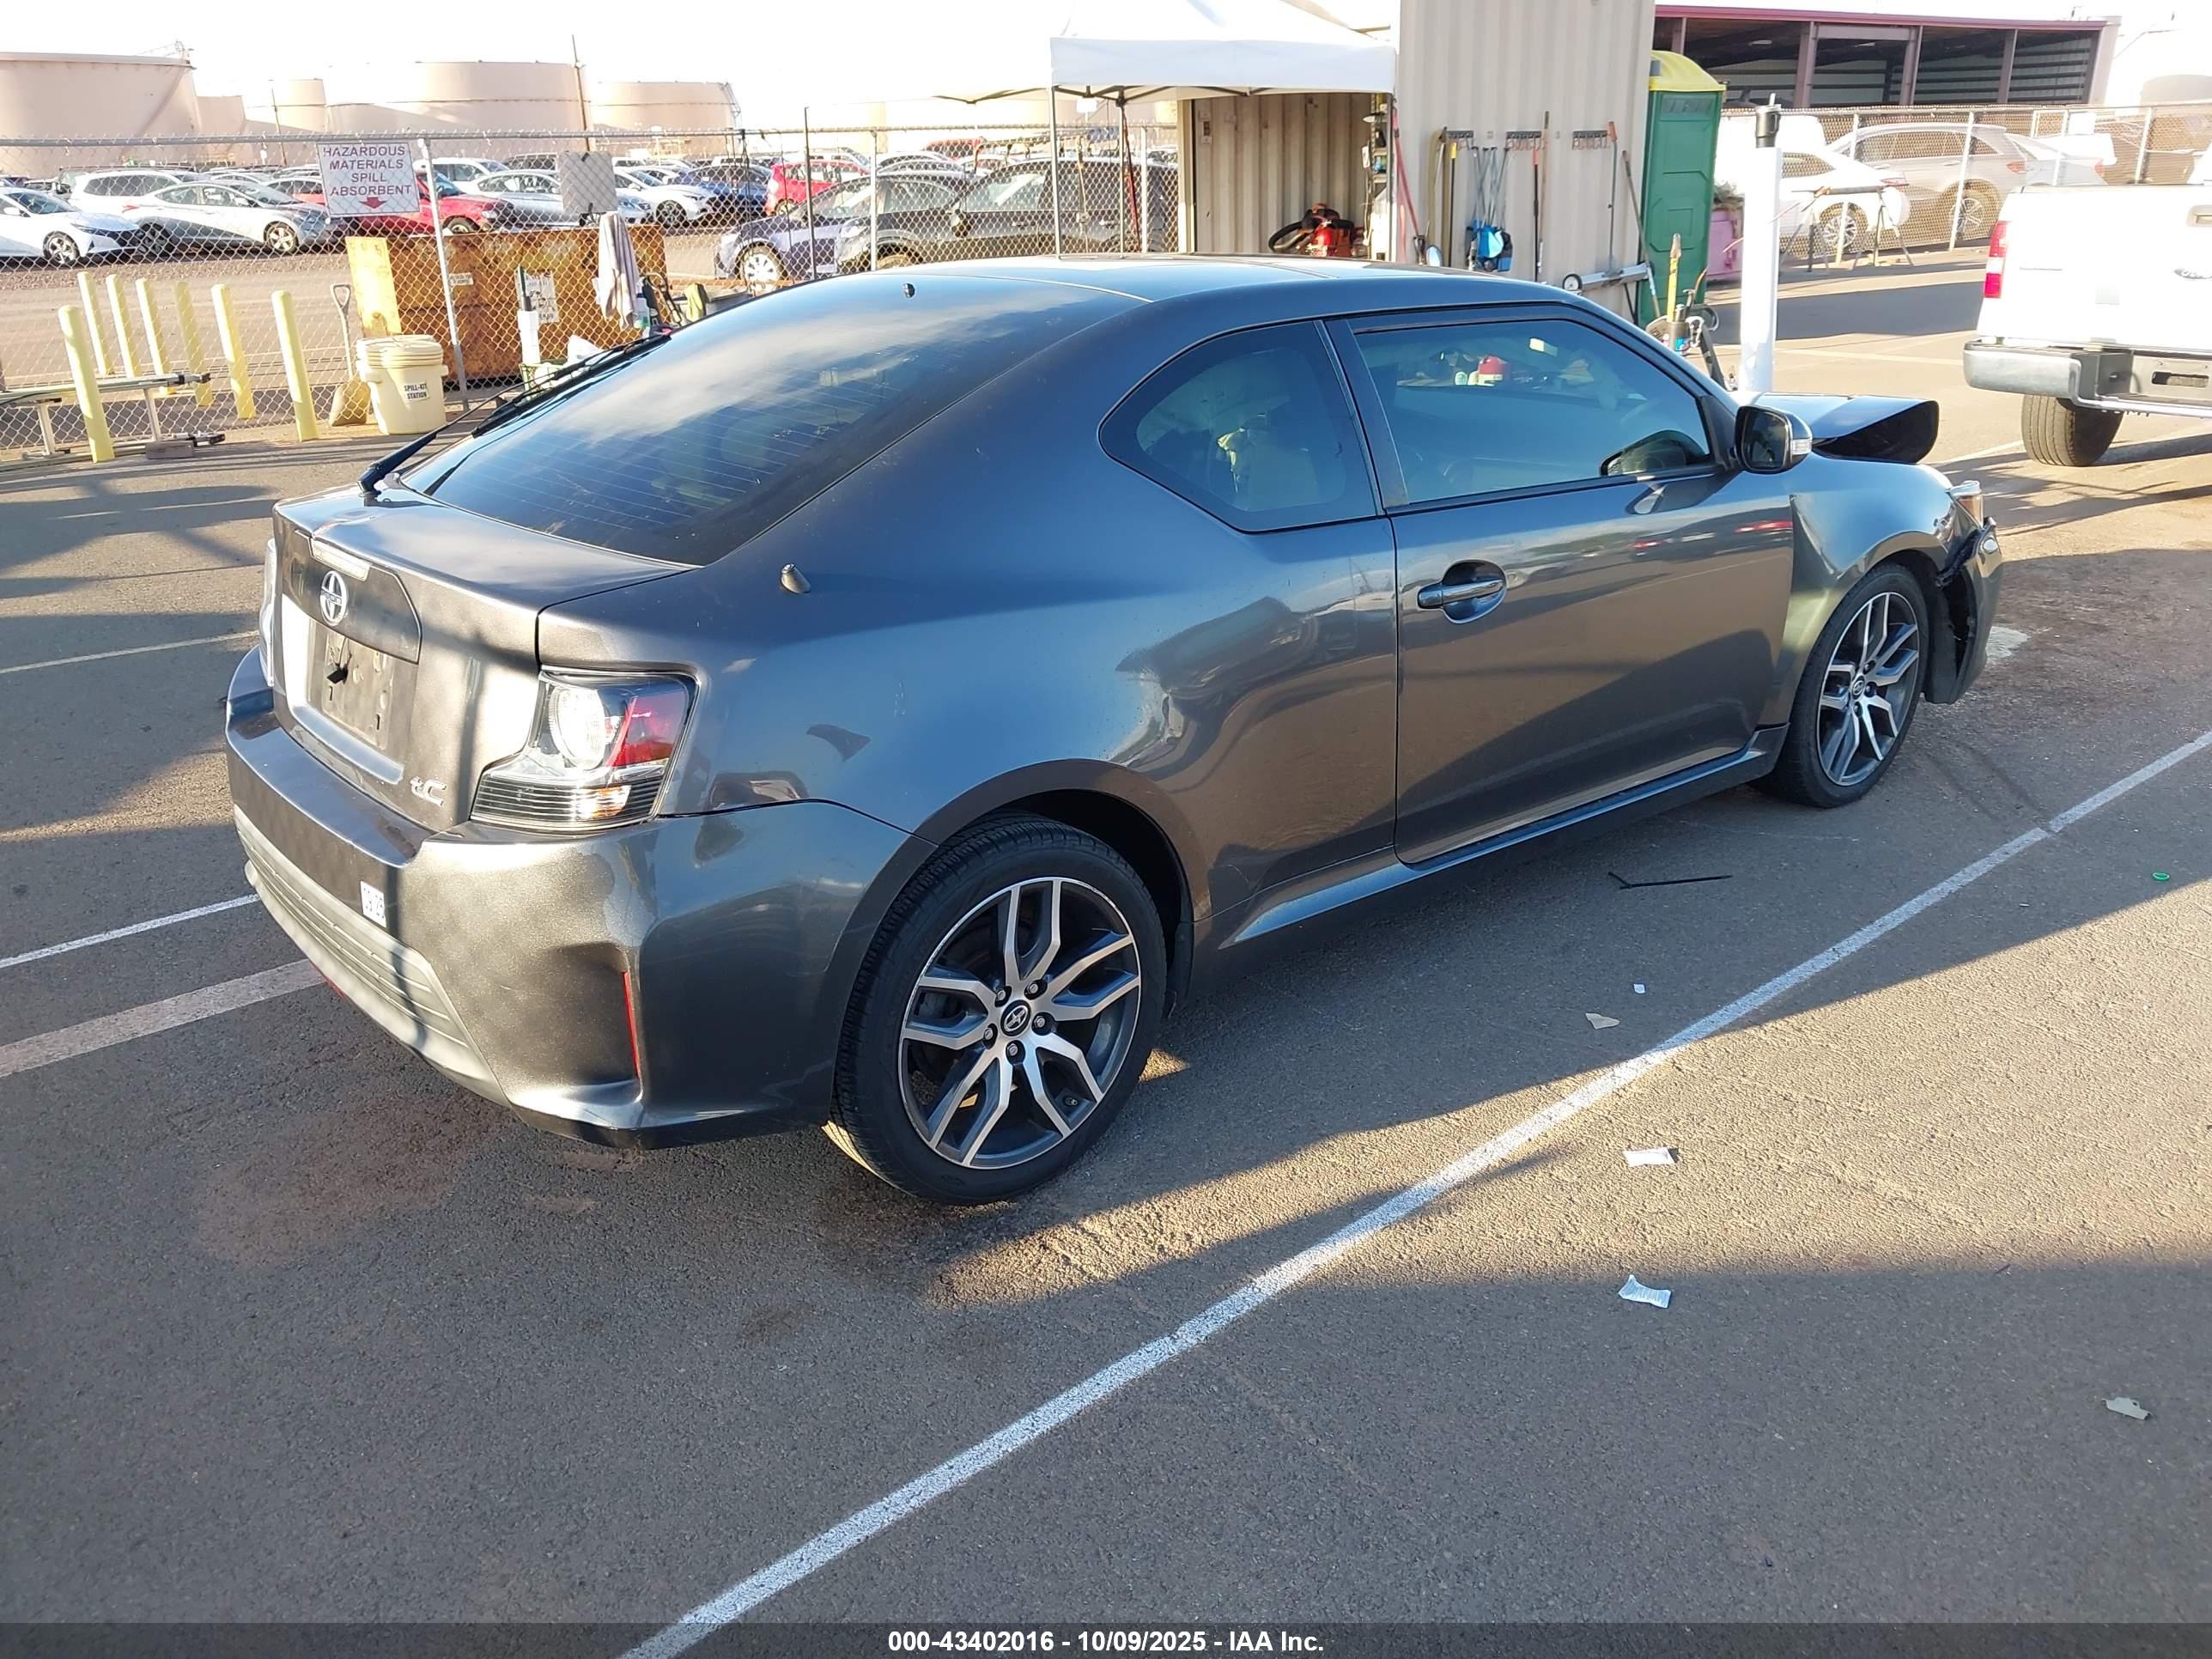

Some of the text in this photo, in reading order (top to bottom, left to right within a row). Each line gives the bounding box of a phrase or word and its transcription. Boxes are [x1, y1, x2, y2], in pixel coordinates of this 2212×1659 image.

[323, 146, 405, 157] HAZARDOUS
[329, 159, 404, 170] MATERIALS
[351, 173, 387, 183] SPILL
[330, 185, 411, 196] ABSORBENT
